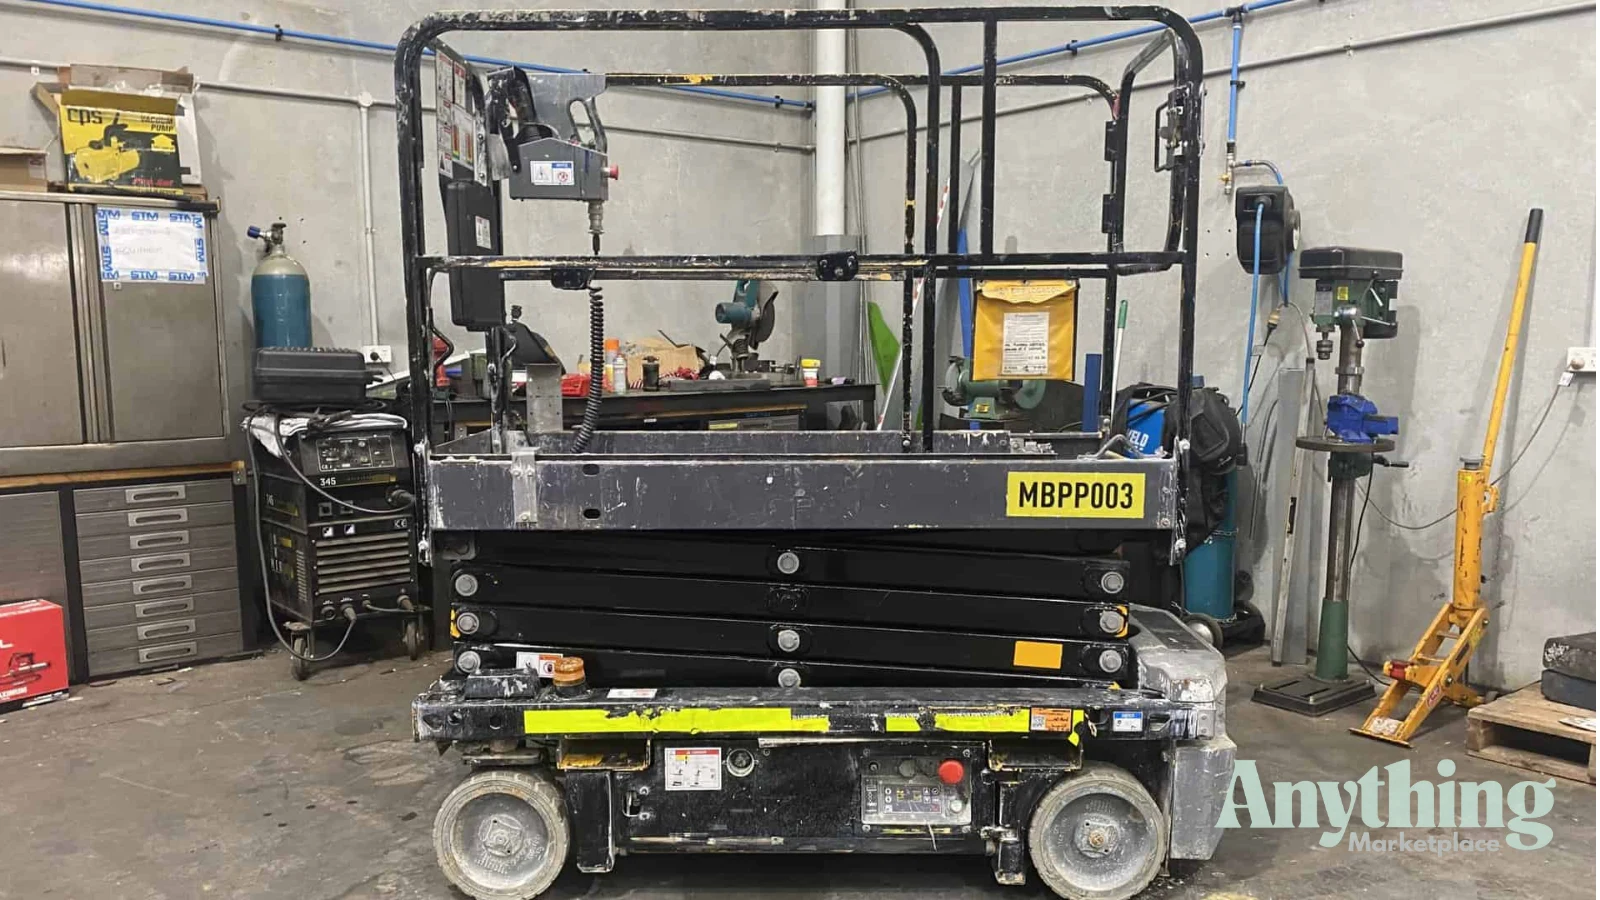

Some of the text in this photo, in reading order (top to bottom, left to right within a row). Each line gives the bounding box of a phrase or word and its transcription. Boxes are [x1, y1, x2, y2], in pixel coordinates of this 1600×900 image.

[151, 124, 175, 132] PUMP
[131, 211, 158, 220] STM
[130, 271, 158, 281] STM
[168, 272, 194, 281] STM
[319, 476, 337, 487] 345
[1019, 481, 1133, 509] MBPP003
